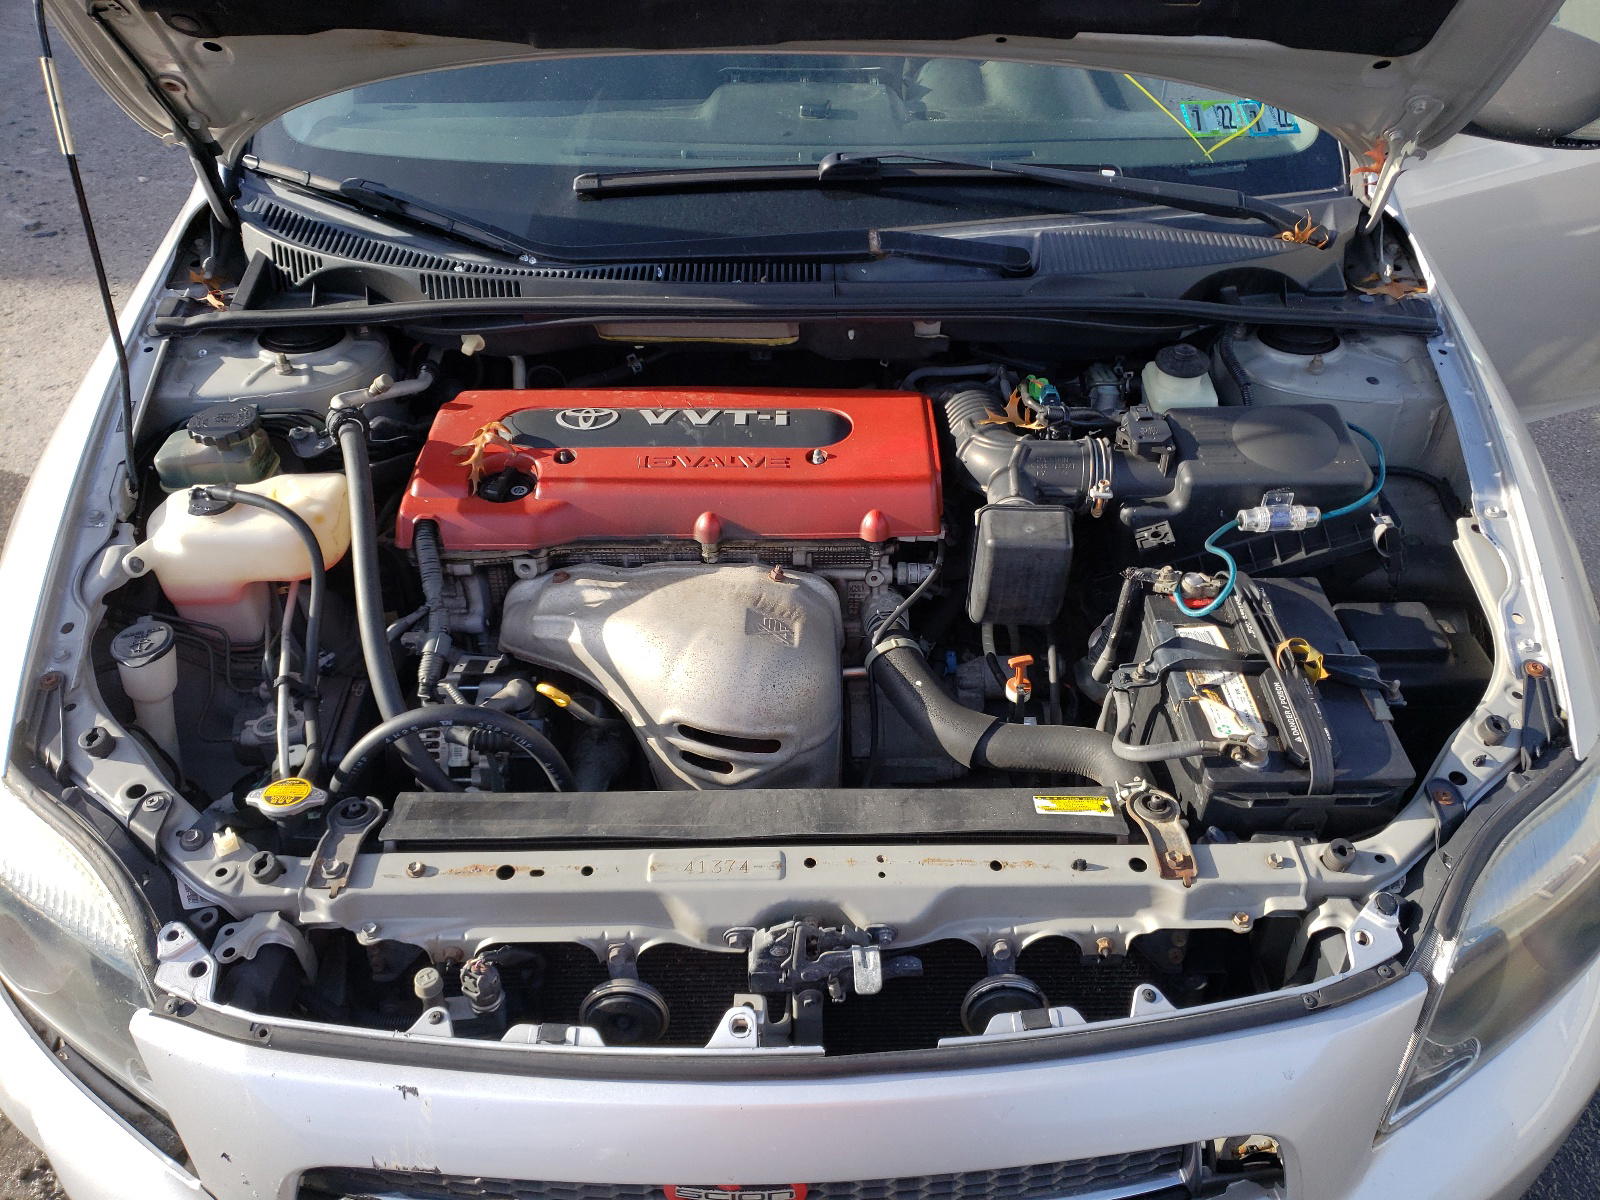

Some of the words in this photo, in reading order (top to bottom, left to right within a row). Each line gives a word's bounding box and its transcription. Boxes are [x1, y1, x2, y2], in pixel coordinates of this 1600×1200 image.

[1216, 105, 1238, 129] 22
[1273, 681, 1288, 705] POISON
[1284, 710, 1300, 737] DANGER
